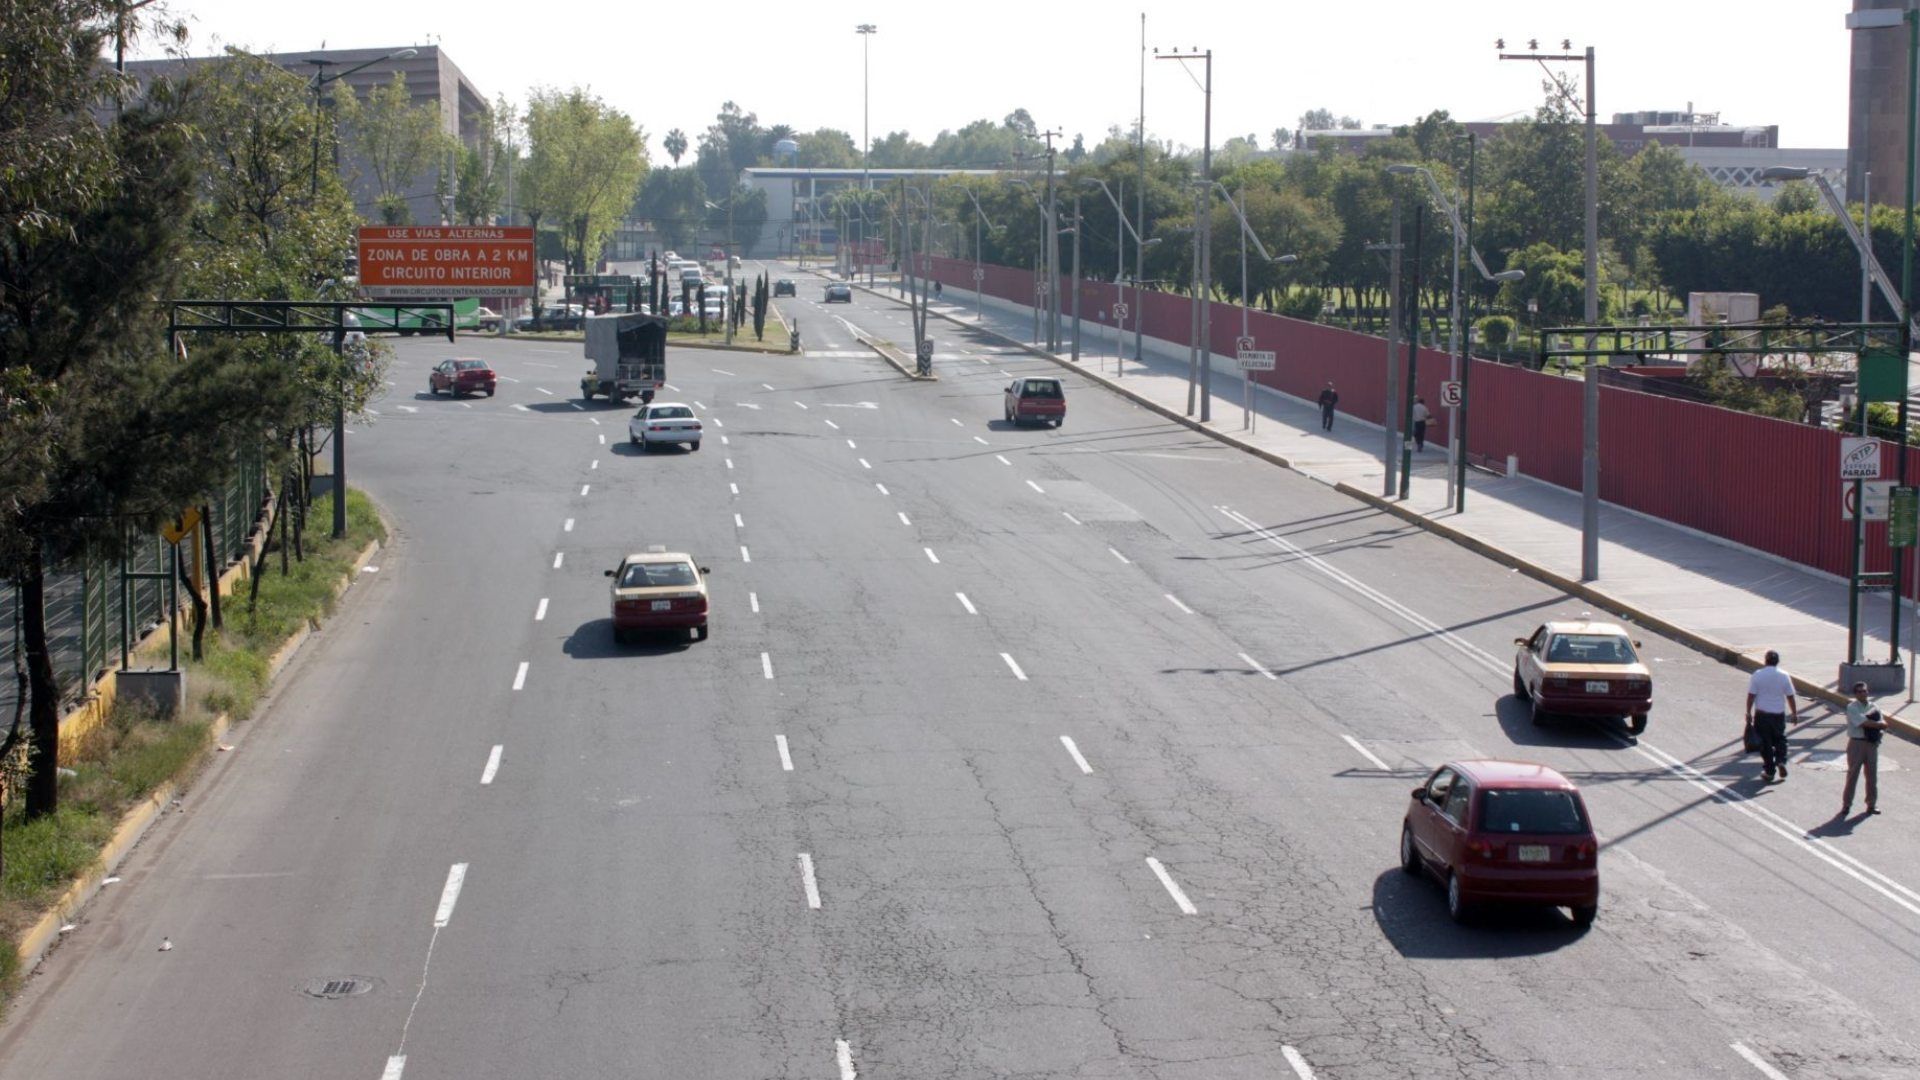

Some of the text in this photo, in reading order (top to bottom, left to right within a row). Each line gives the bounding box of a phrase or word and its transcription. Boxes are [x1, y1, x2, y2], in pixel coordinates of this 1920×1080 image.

[387, 229, 409, 238] USE
[448, 229, 504, 238] ALTERNAS
[367, 249, 528, 262] ZONA DE OBRA A 2 KM
[382, 266, 511, 279] CIRCUITO INTERIOR
[1850, 446, 1872, 462] RTP
[1842, 469, 1877, 477] PARADA
